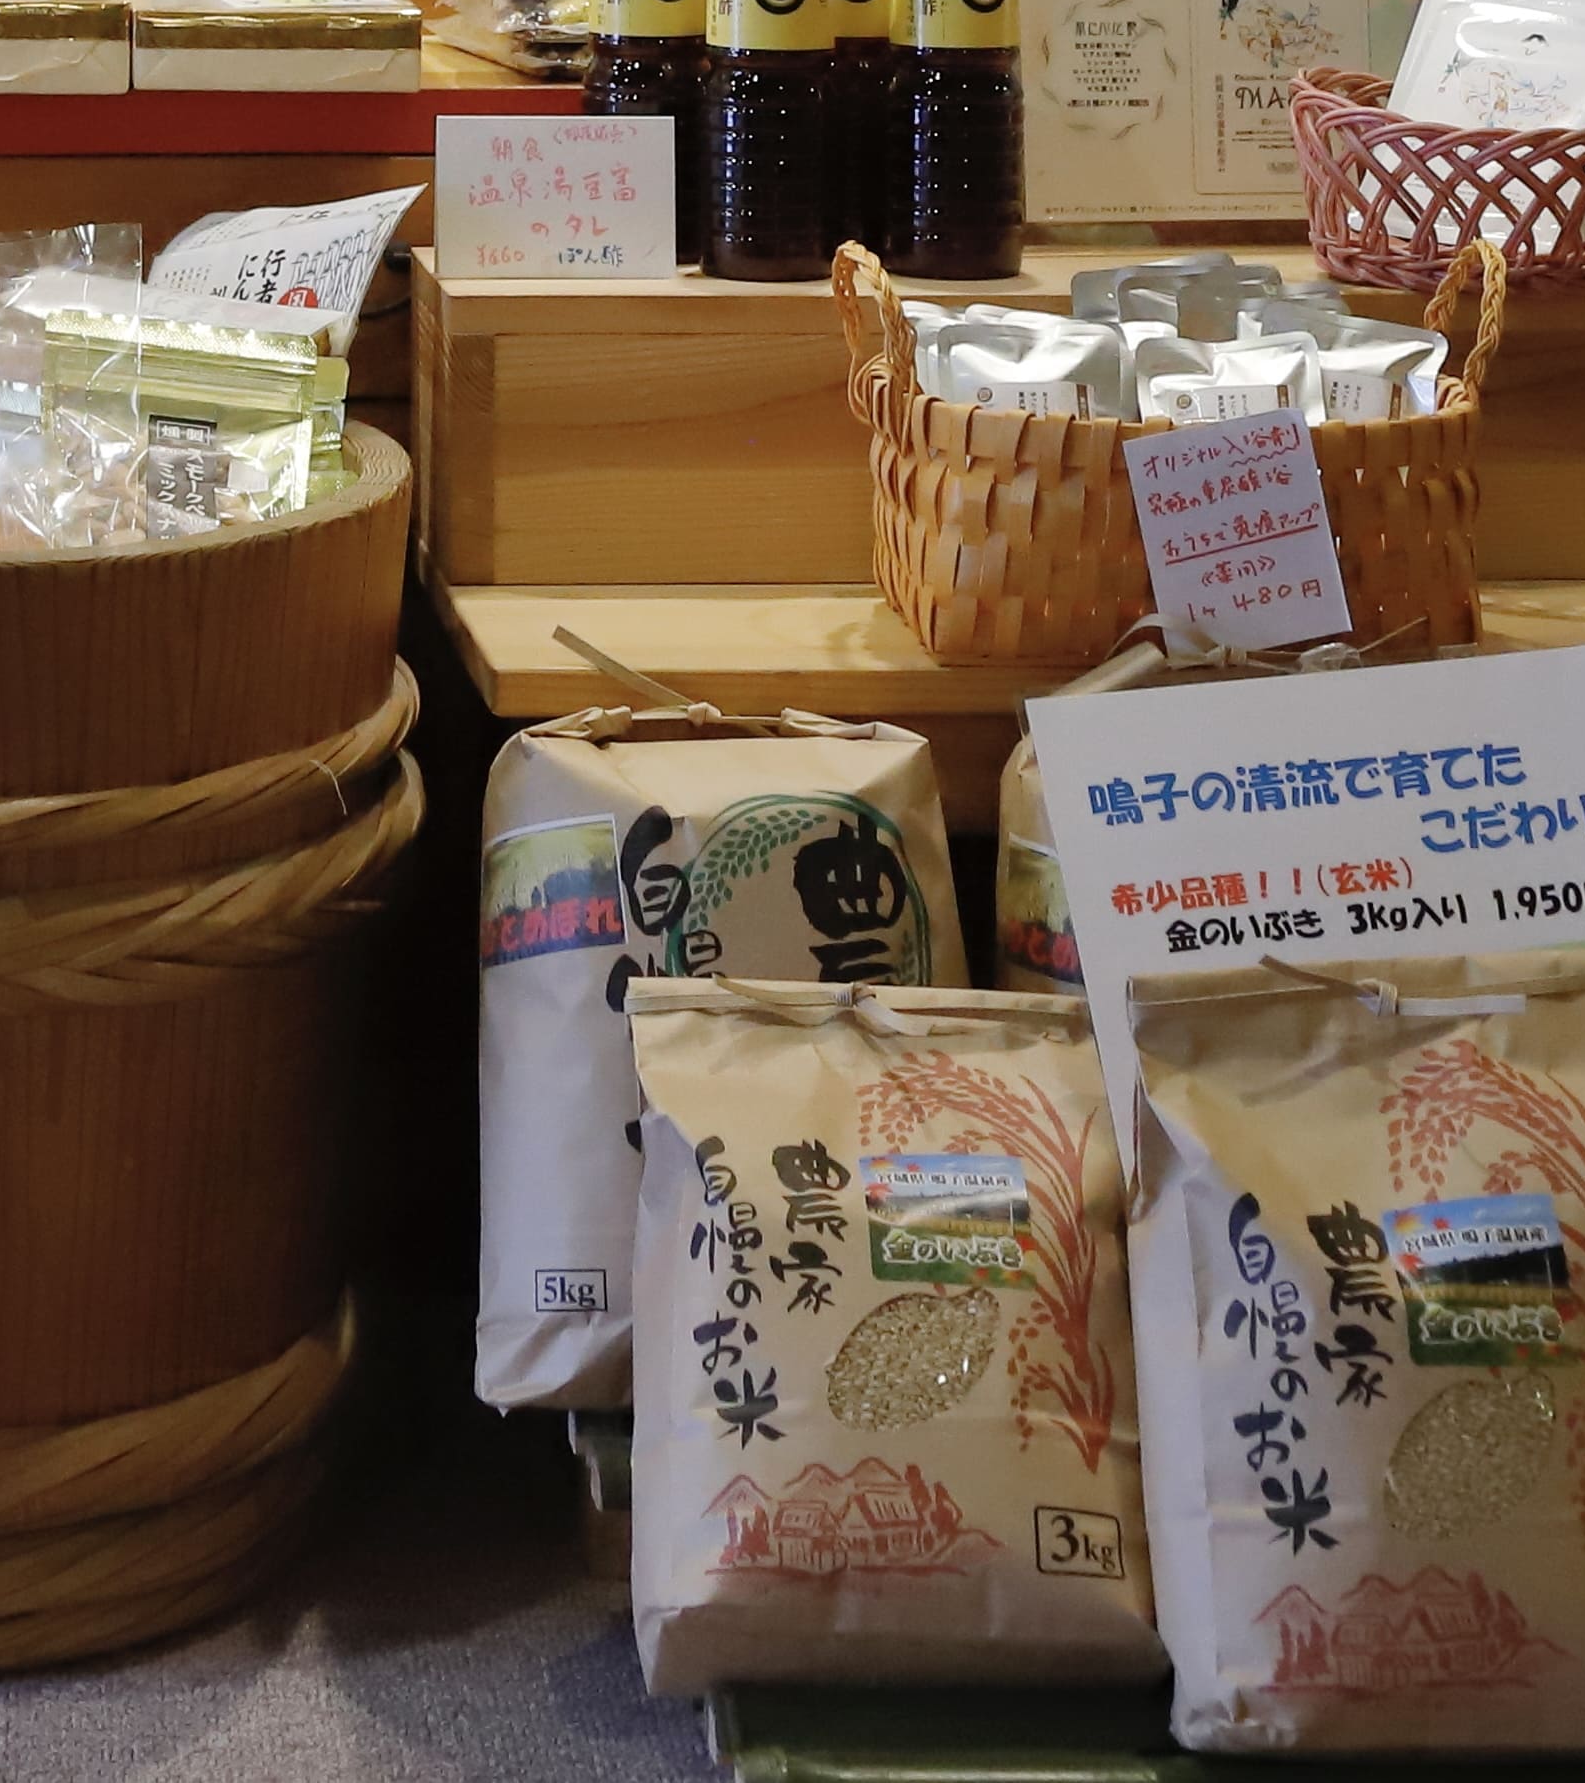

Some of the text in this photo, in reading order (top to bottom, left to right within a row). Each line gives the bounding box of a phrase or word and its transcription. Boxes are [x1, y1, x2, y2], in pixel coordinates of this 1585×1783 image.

[1235, 86, 1292, 109] MA
[491, 136, 543, 162] 朝食
[559, 245, 624, 268] ぽん酢
[1143, 423, 1301, 478] オリジナル入浴剤
[1233, 579, 1322, 612] 480円
[1088, 743, 1527, 828] 鳴子の清流で育てた
[1166, 909, 1325, 954] 金のいぶき
[770, 1139, 852, 1316] 農家
[884, 1232, 1024, 1267] 金のいぶき
[543, 1277, 595, 1308] 5kg
[690, 1136, 787, 1450] 自慢のお米
[1307, 1198, 1396, 1410] 農家
[1224, 1192, 1342, 1556] 自慢のお米
[1050, 1514, 1117, 1567] 3kg
